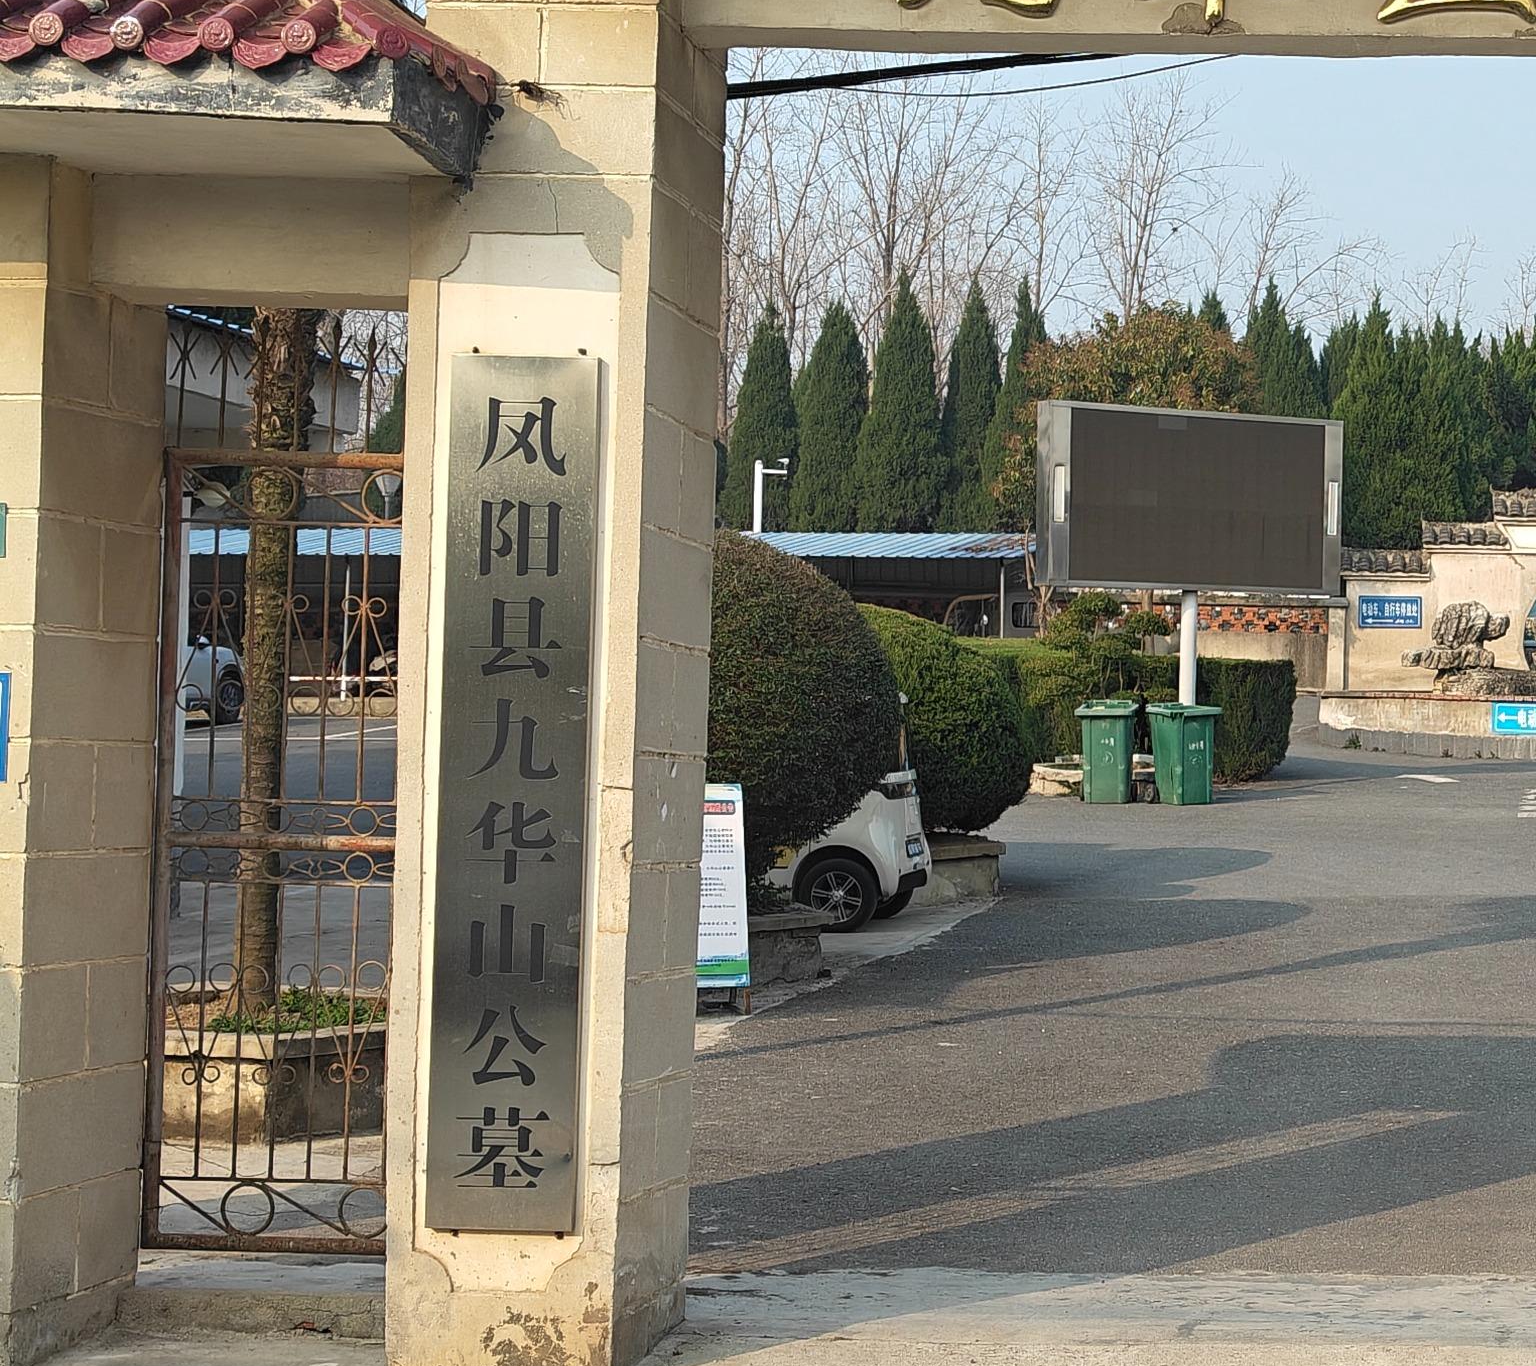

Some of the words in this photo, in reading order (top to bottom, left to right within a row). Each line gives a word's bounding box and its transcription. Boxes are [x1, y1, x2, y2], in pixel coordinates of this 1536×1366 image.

[455, 395, 568, 1190] 凤阳县九华山公墓
